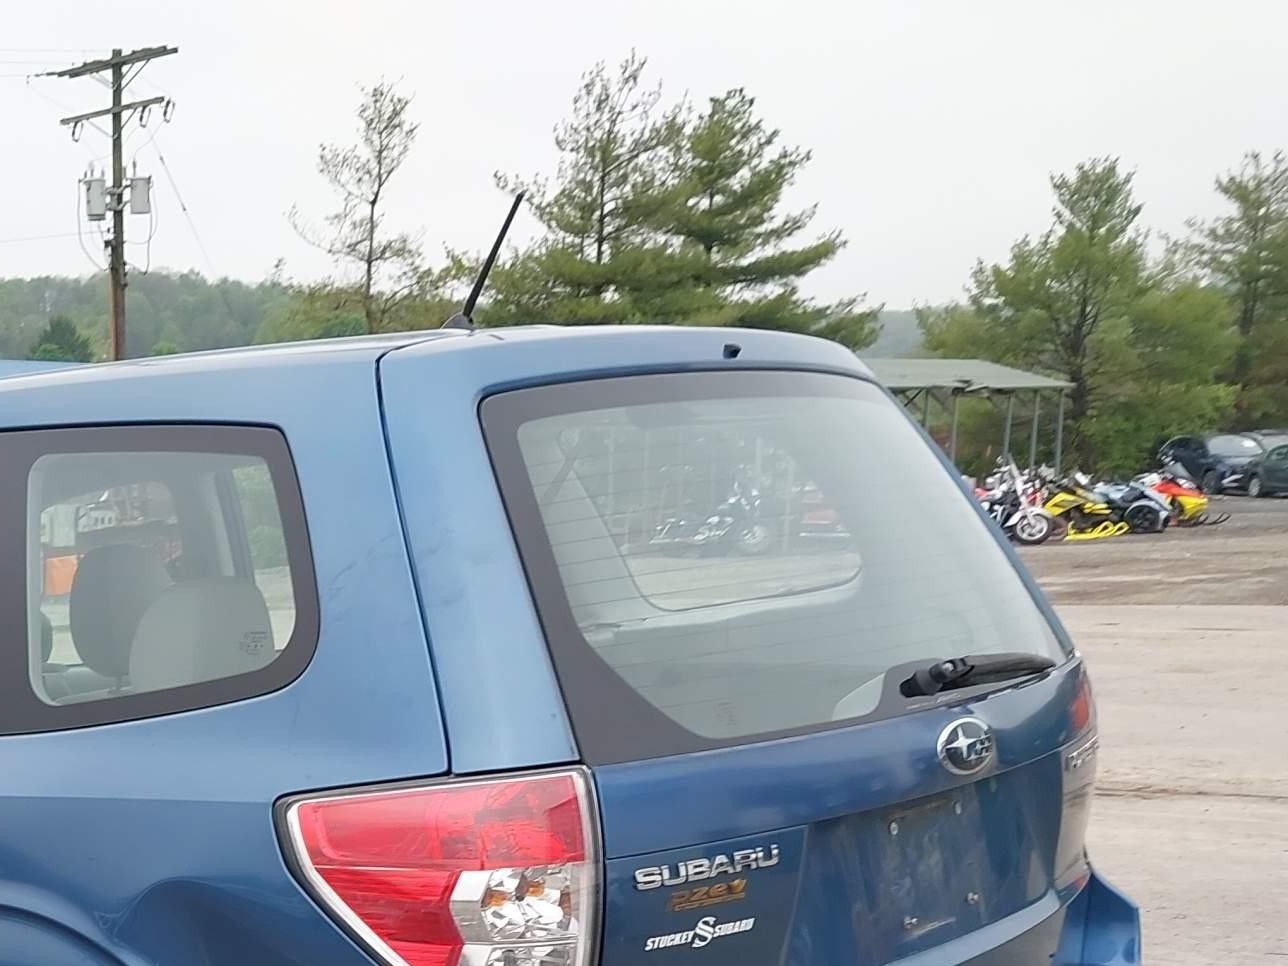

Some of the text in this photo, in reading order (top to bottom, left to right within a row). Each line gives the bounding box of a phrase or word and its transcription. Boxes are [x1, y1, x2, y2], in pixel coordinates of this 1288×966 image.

[634, 844, 780, 891] SUBARU
[644, 931, 695, 951] STUCKEY
[713, 917, 756, 938] SUBARU
